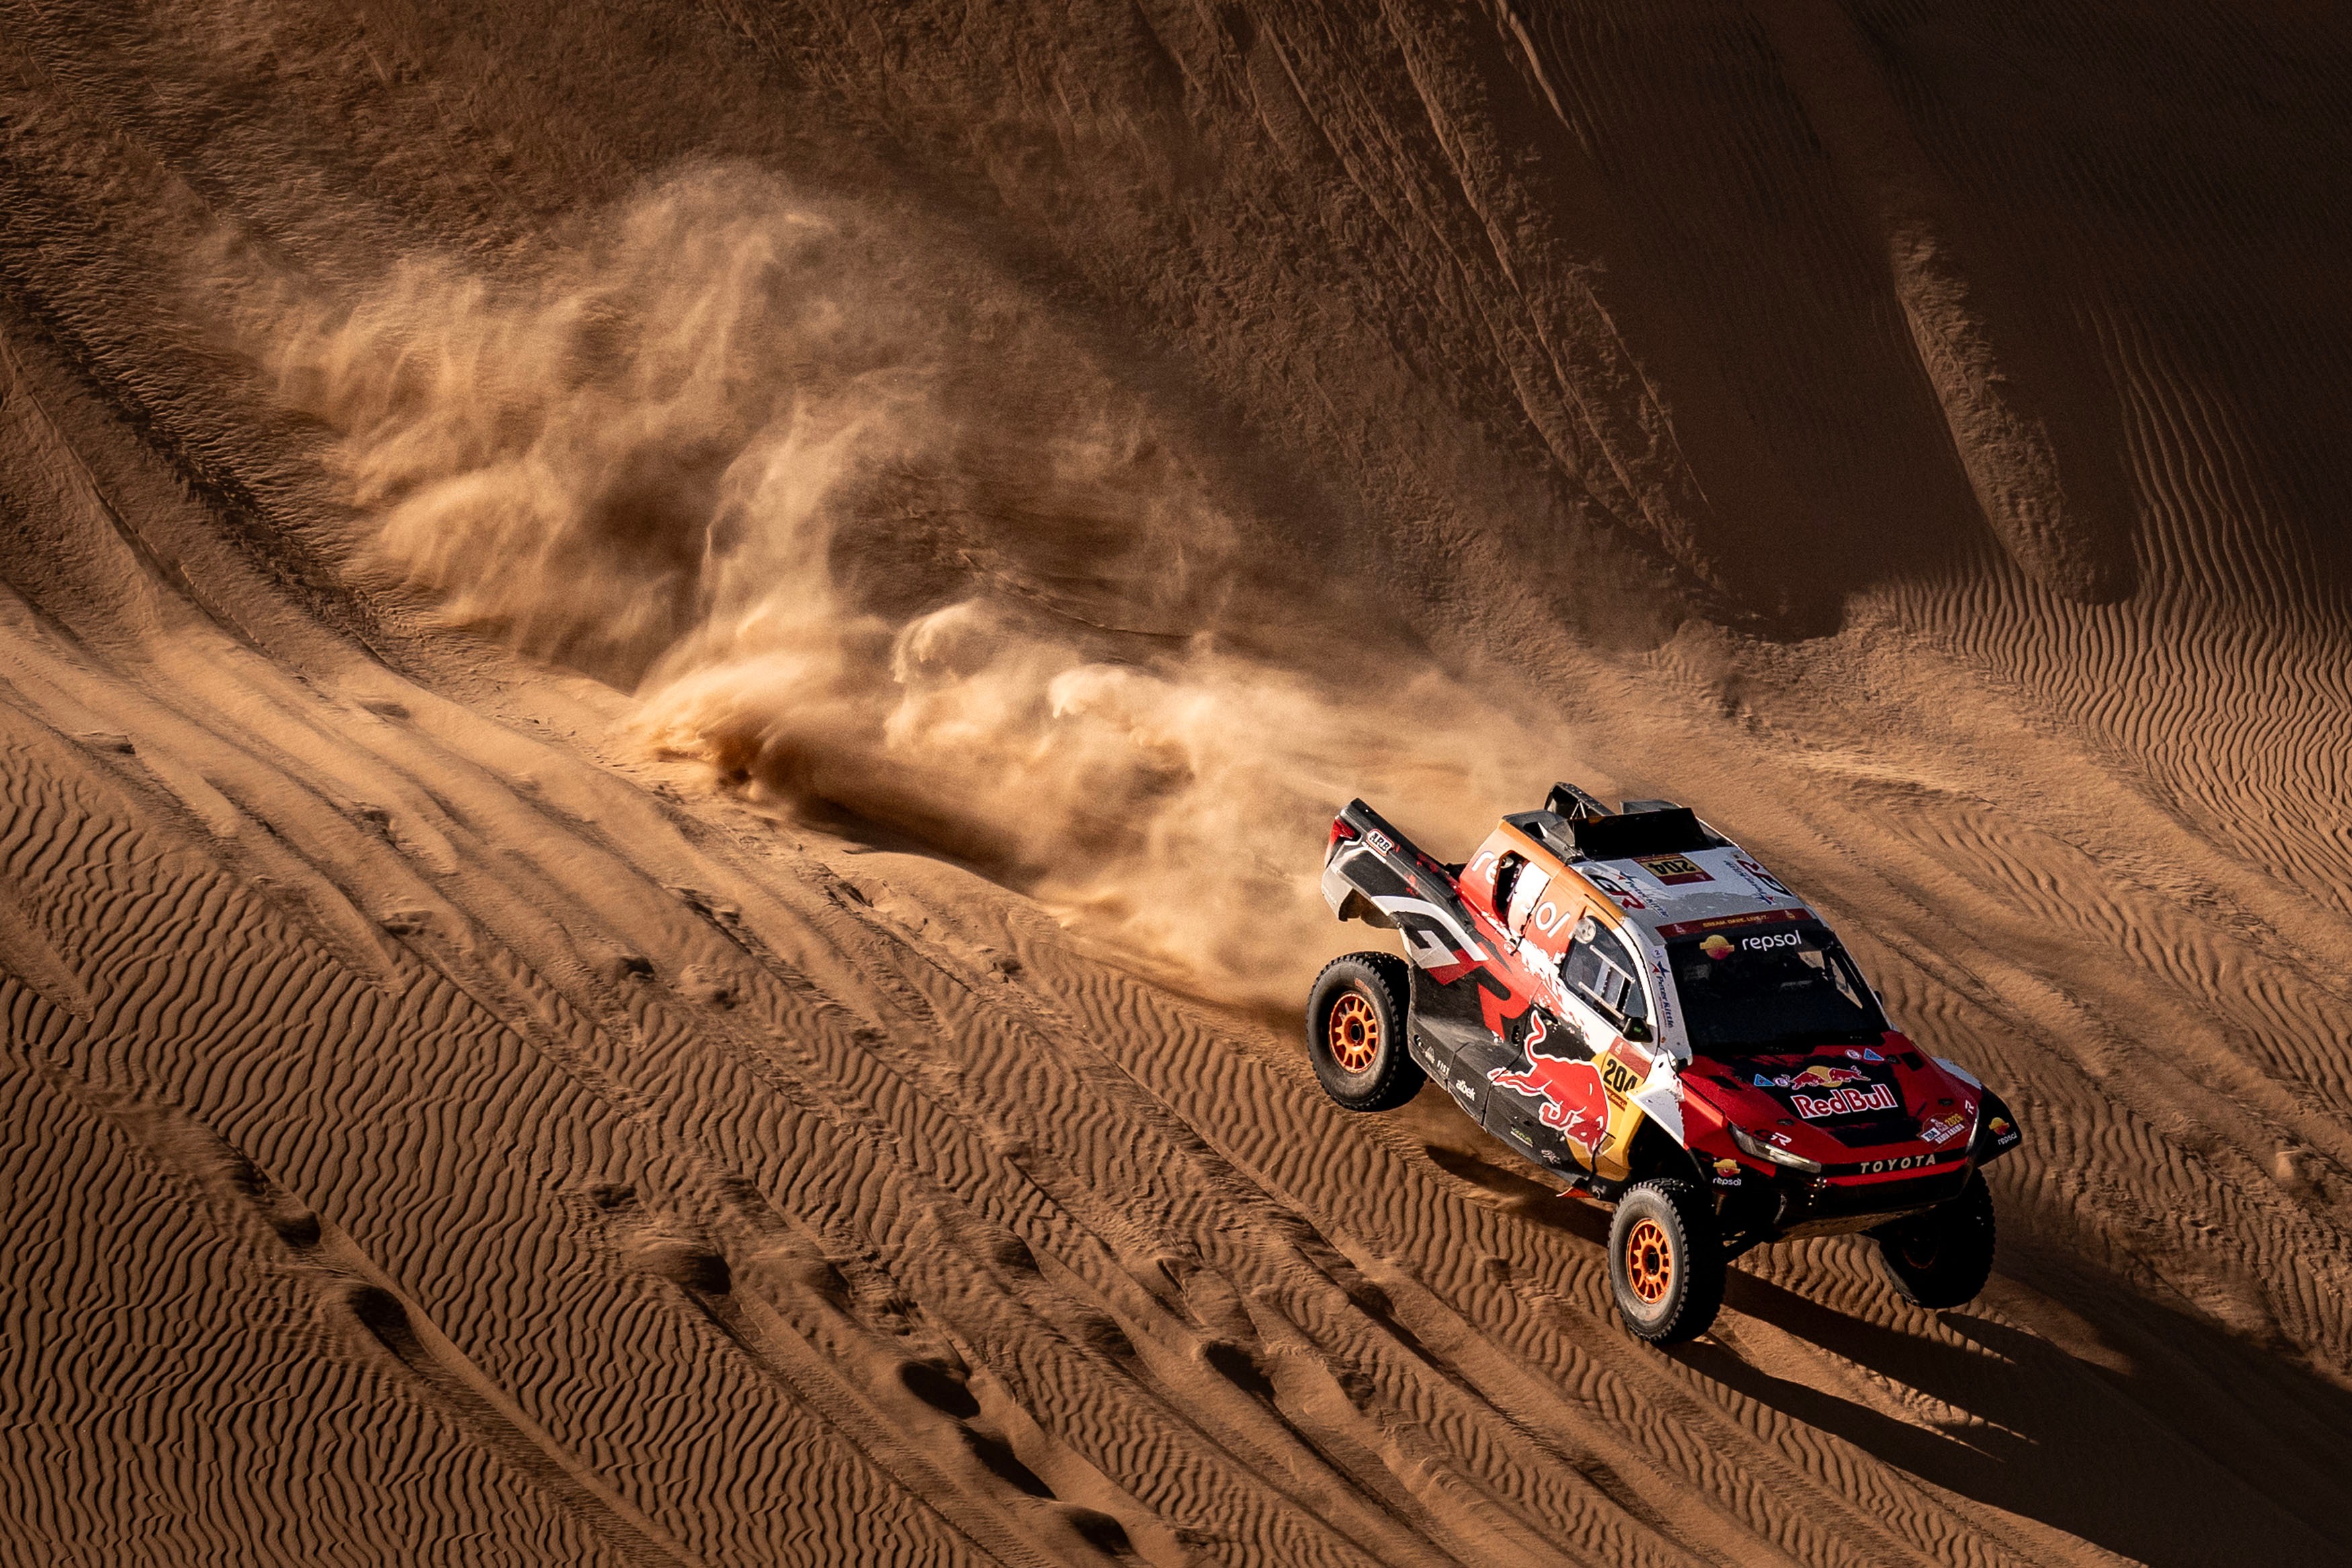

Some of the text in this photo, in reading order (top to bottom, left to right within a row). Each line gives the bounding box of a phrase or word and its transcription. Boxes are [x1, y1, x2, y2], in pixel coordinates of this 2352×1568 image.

[1369, 832, 1390, 852] ARB
[1648, 860, 1696, 875] 204
[1742, 930, 1802, 951] repsol
[1997, 1131, 2018, 1145] repsol
[1860, 1154, 1935, 1174] TOYOTA
[1712, 1178, 1742, 1186] repsol
